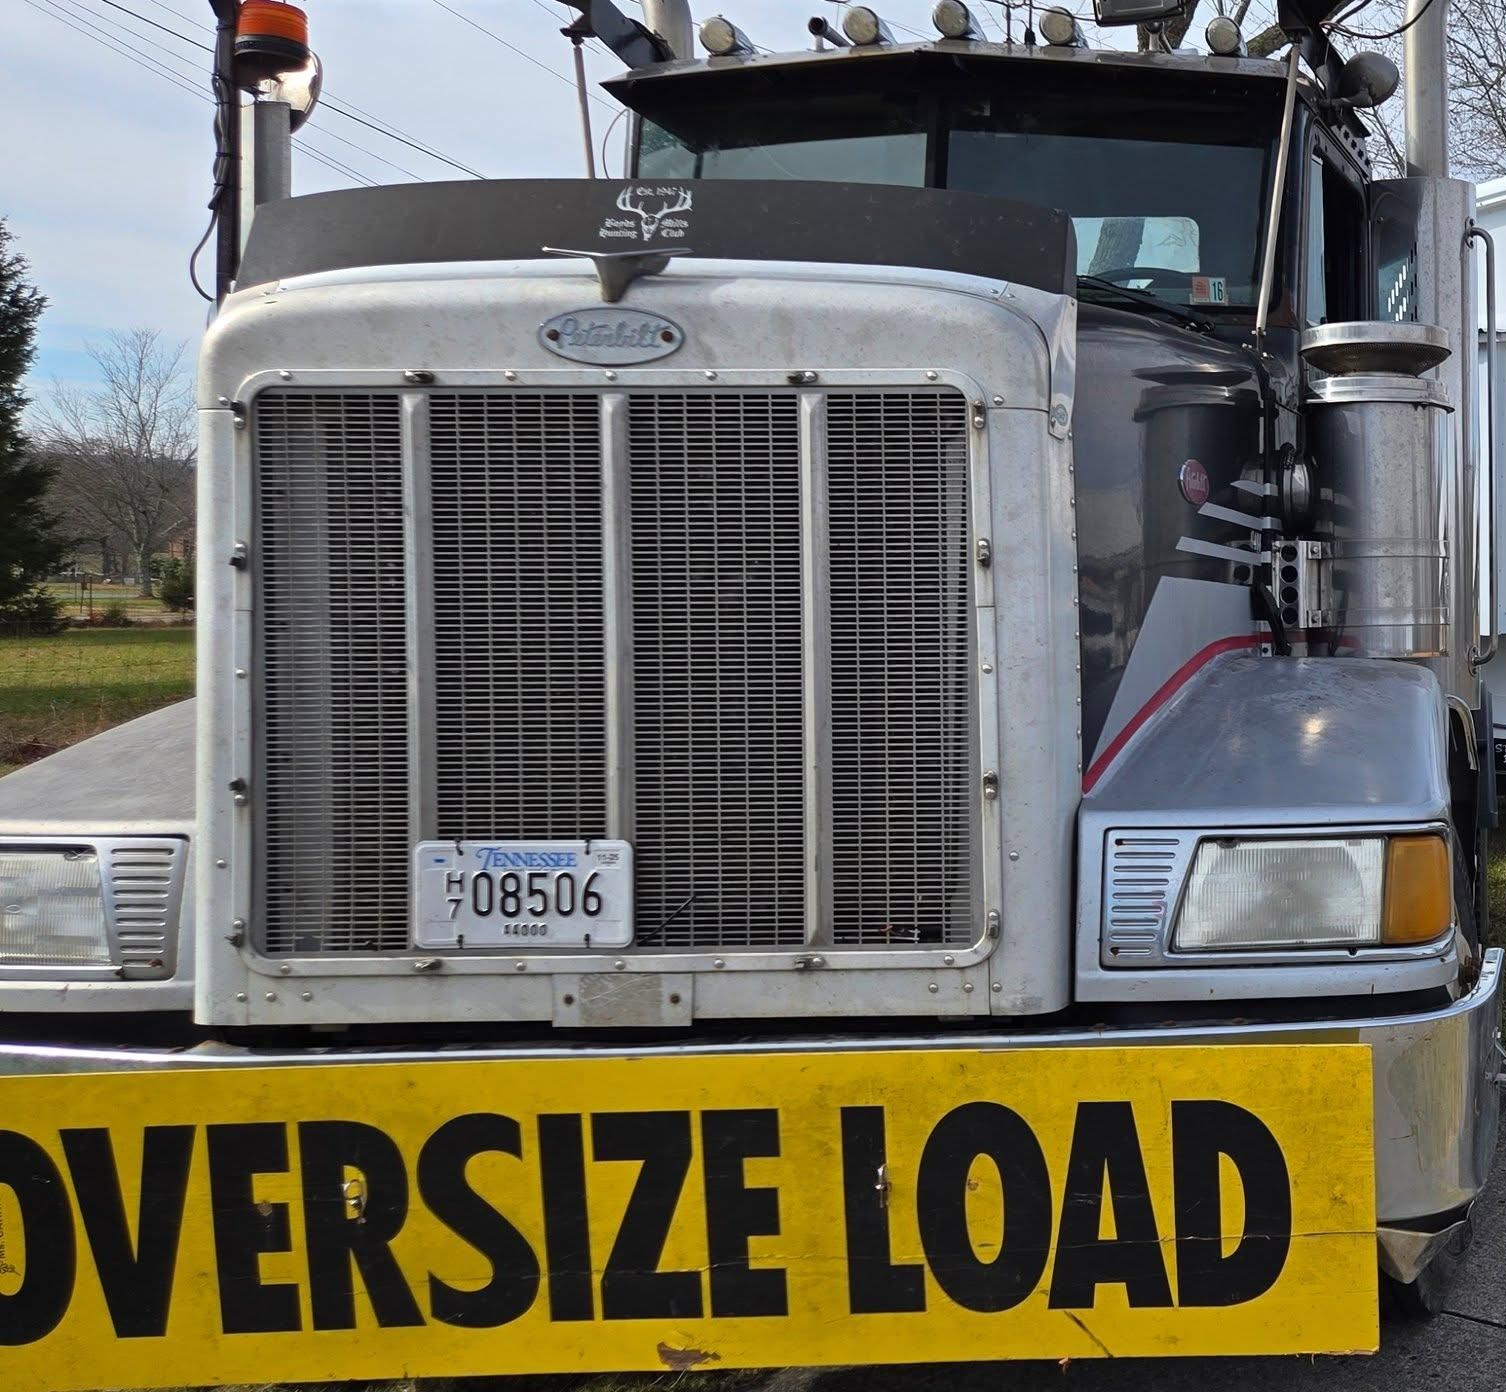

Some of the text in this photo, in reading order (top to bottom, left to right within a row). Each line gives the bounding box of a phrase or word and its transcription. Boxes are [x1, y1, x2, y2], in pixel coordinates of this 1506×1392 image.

[556, 317, 671, 349] Peterbilt
[475, 847, 577, 870] TENNESSEE
[446, 872, 464, 893] H
[472, 872, 601, 917] 08506
[447, 898, 463, 920] 7
[0, 1100, 1293, 1347] OVERSIZE LOAD
